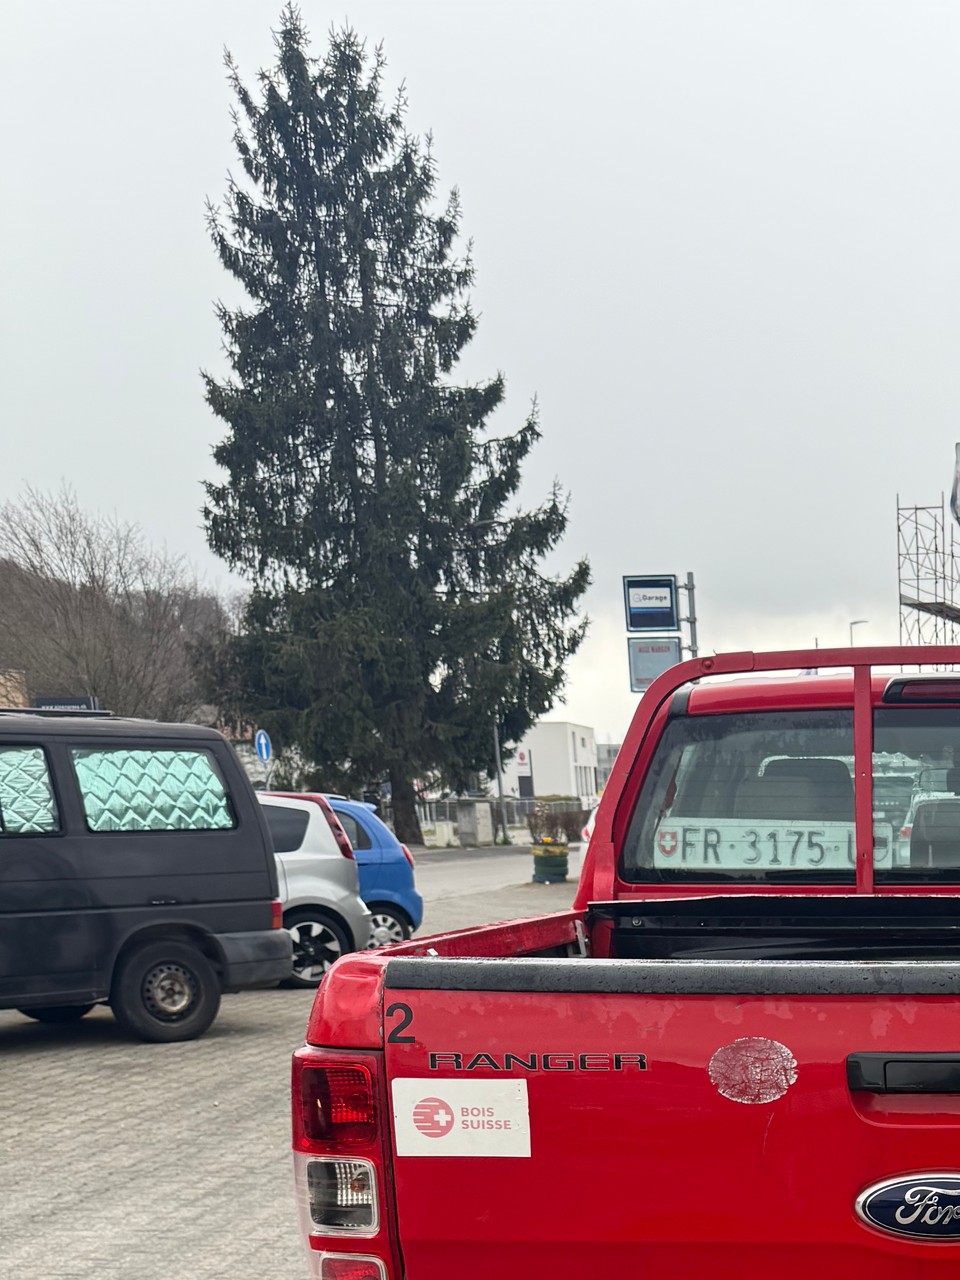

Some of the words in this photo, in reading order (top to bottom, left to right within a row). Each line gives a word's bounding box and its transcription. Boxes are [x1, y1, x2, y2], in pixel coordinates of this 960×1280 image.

[642, 594, 668, 602] Garage
[386, 1003, 415, 1043] 2
[429, 1052, 648, 1071] RANGER
[461, 1107, 494, 1117] BOIS
[461, 1119, 511, 1130] SUISSE
